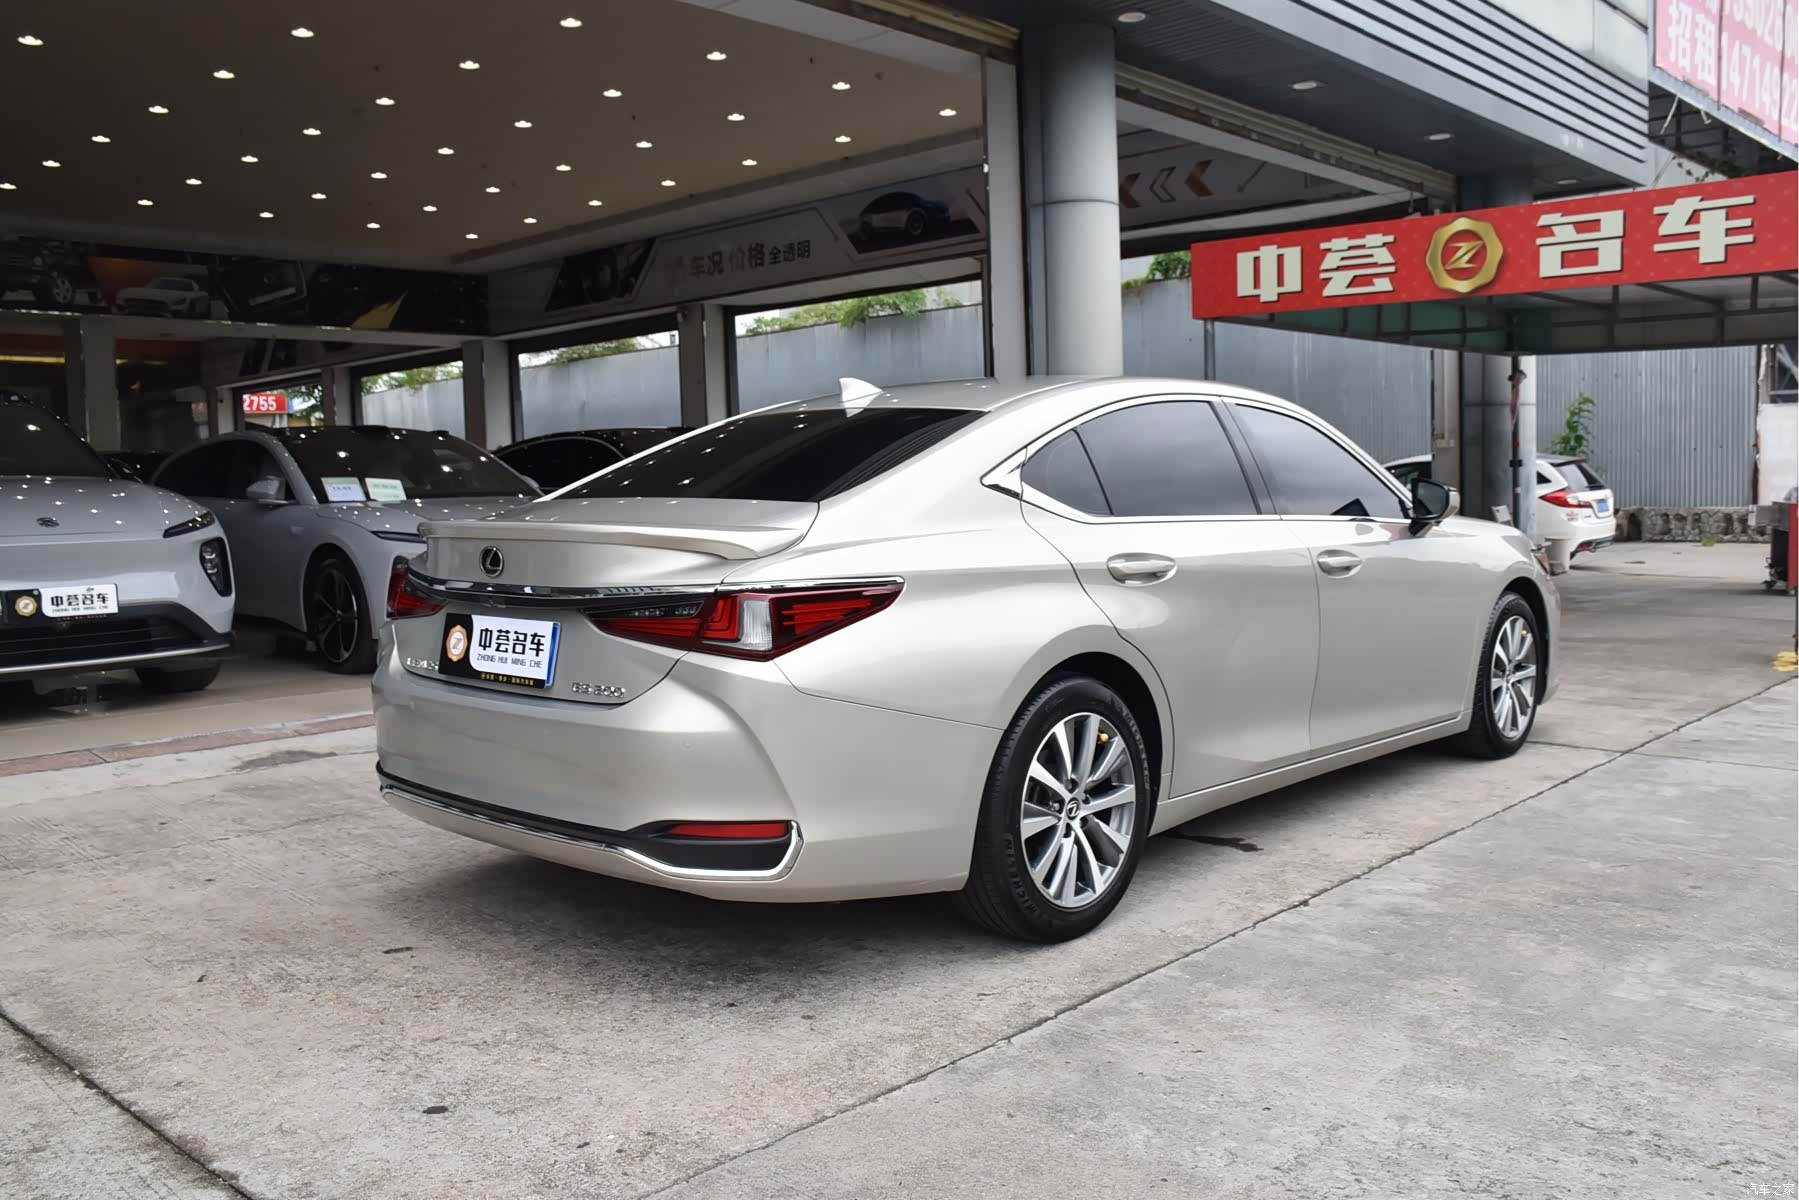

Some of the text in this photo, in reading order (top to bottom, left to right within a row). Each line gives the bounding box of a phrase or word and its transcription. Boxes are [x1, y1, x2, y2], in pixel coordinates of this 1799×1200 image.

[1667, 0, 1716, 86] 招租
[1236, 232, 1397, 303] 中荟
[1535, 194, 1756, 280] 名车
[50, 592, 109, 607] 中荟名车
[478, 627, 546, 657] 中荟名车
[476, 653, 543, 669] ZHONG HUI MING CHE
